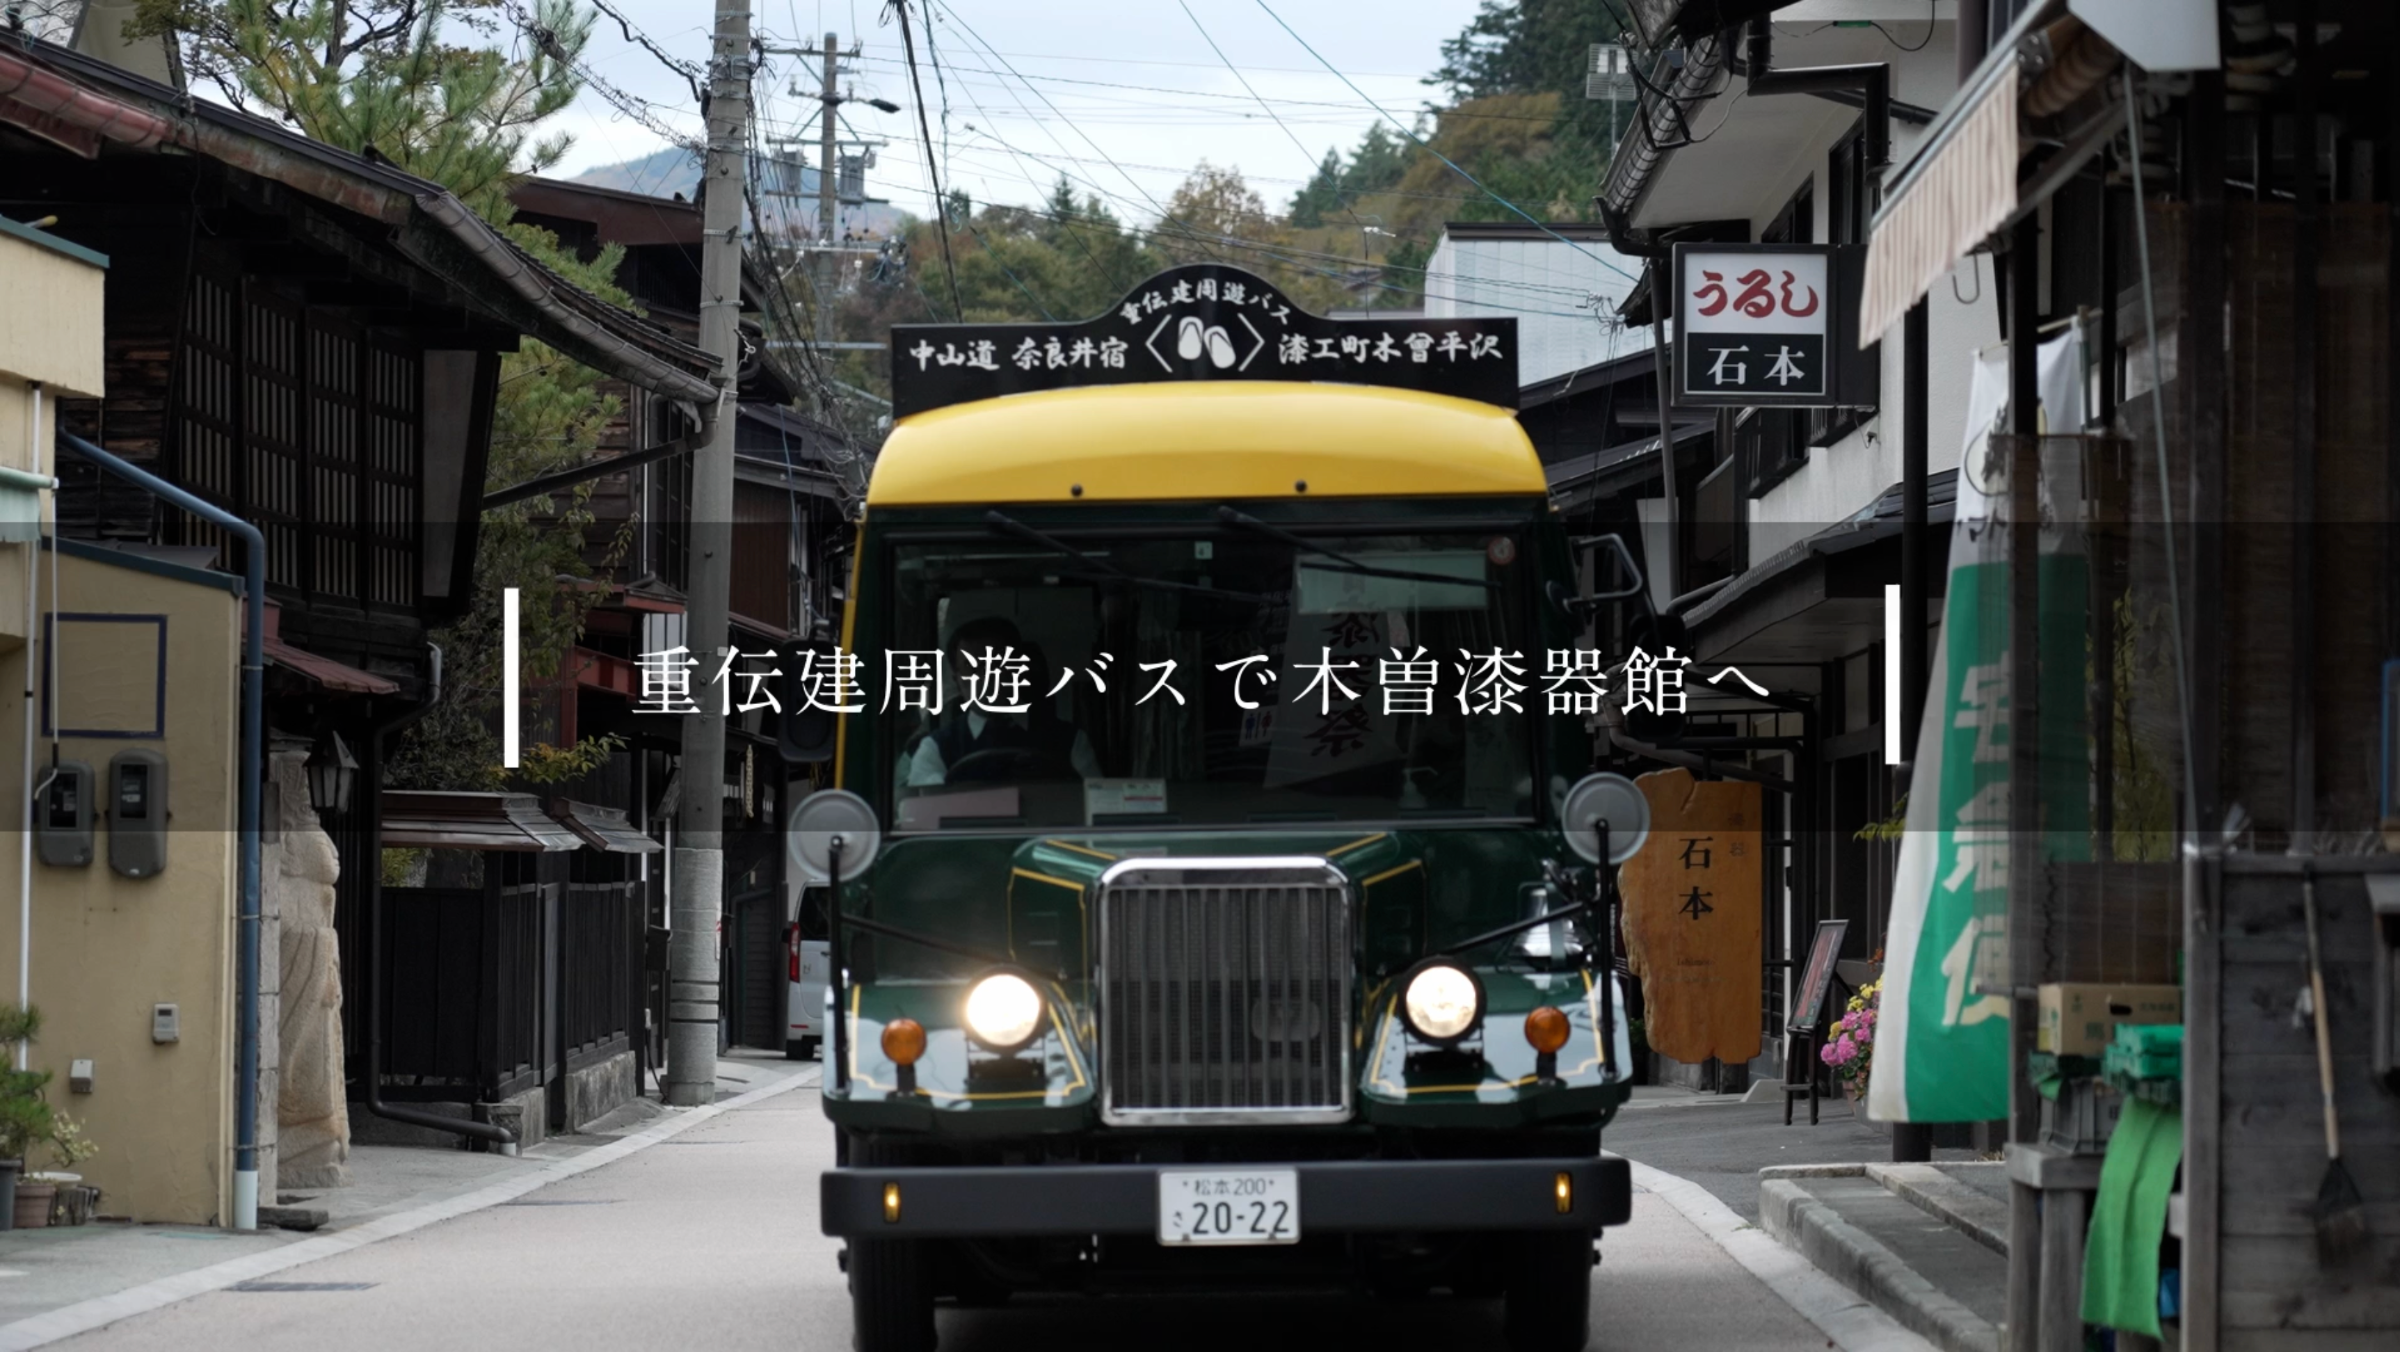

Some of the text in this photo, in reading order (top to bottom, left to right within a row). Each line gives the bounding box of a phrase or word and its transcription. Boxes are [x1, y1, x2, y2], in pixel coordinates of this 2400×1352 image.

[1119, 278, 1291, 326] 重伝建周遊バス
[1692, 268, 1819, 319] うるし
[909, 339, 1000, 371] 中山道
[1012, 336, 1128, 370] 奈良井宿
[1706, 344, 1806, 386] 石本
[1678, 835, 1715, 921] 石本
[1191, 1200, 1290, 1235] 20-22
